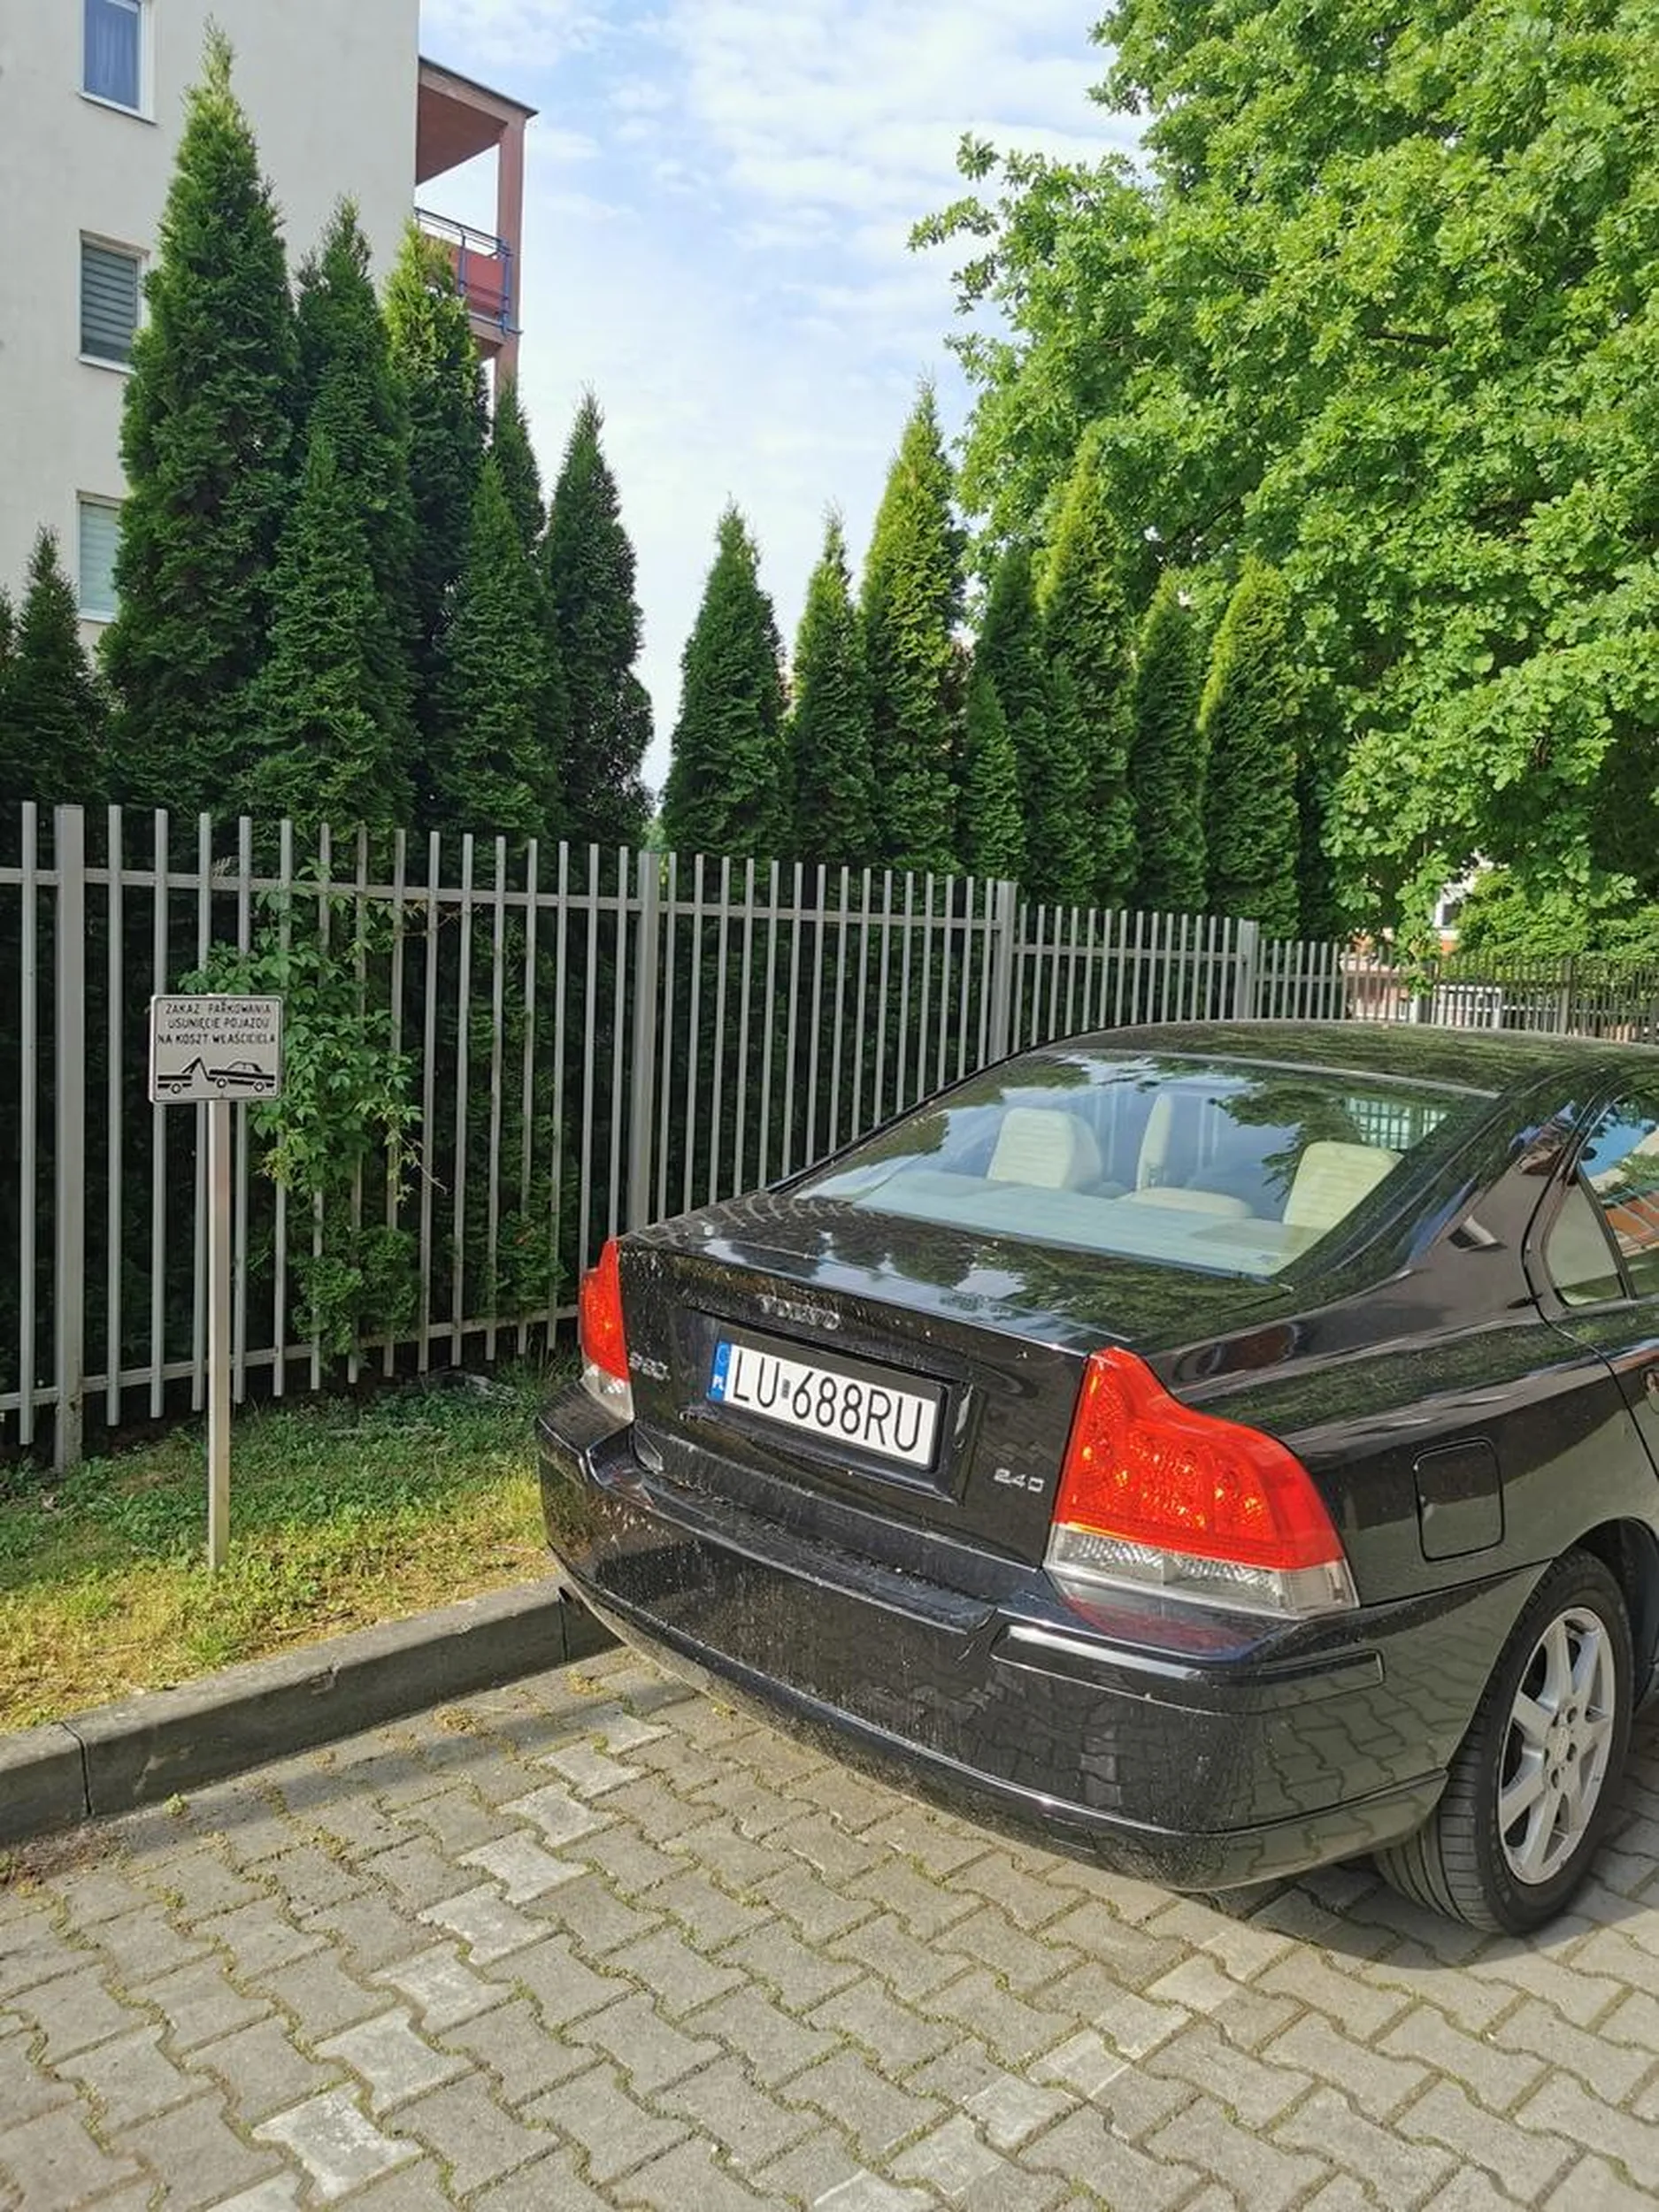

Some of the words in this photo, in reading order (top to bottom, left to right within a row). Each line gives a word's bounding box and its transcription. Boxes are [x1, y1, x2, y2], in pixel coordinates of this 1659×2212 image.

[165, 1002, 199, 1015] ZAKAZ
[208, 1002, 271, 1014] PARKOWANIA
[224, 1017, 270, 1029] POJAZDU
[157, 1033, 173, 1044] NA
[175, 1033, 208, 1044] KOSZT
